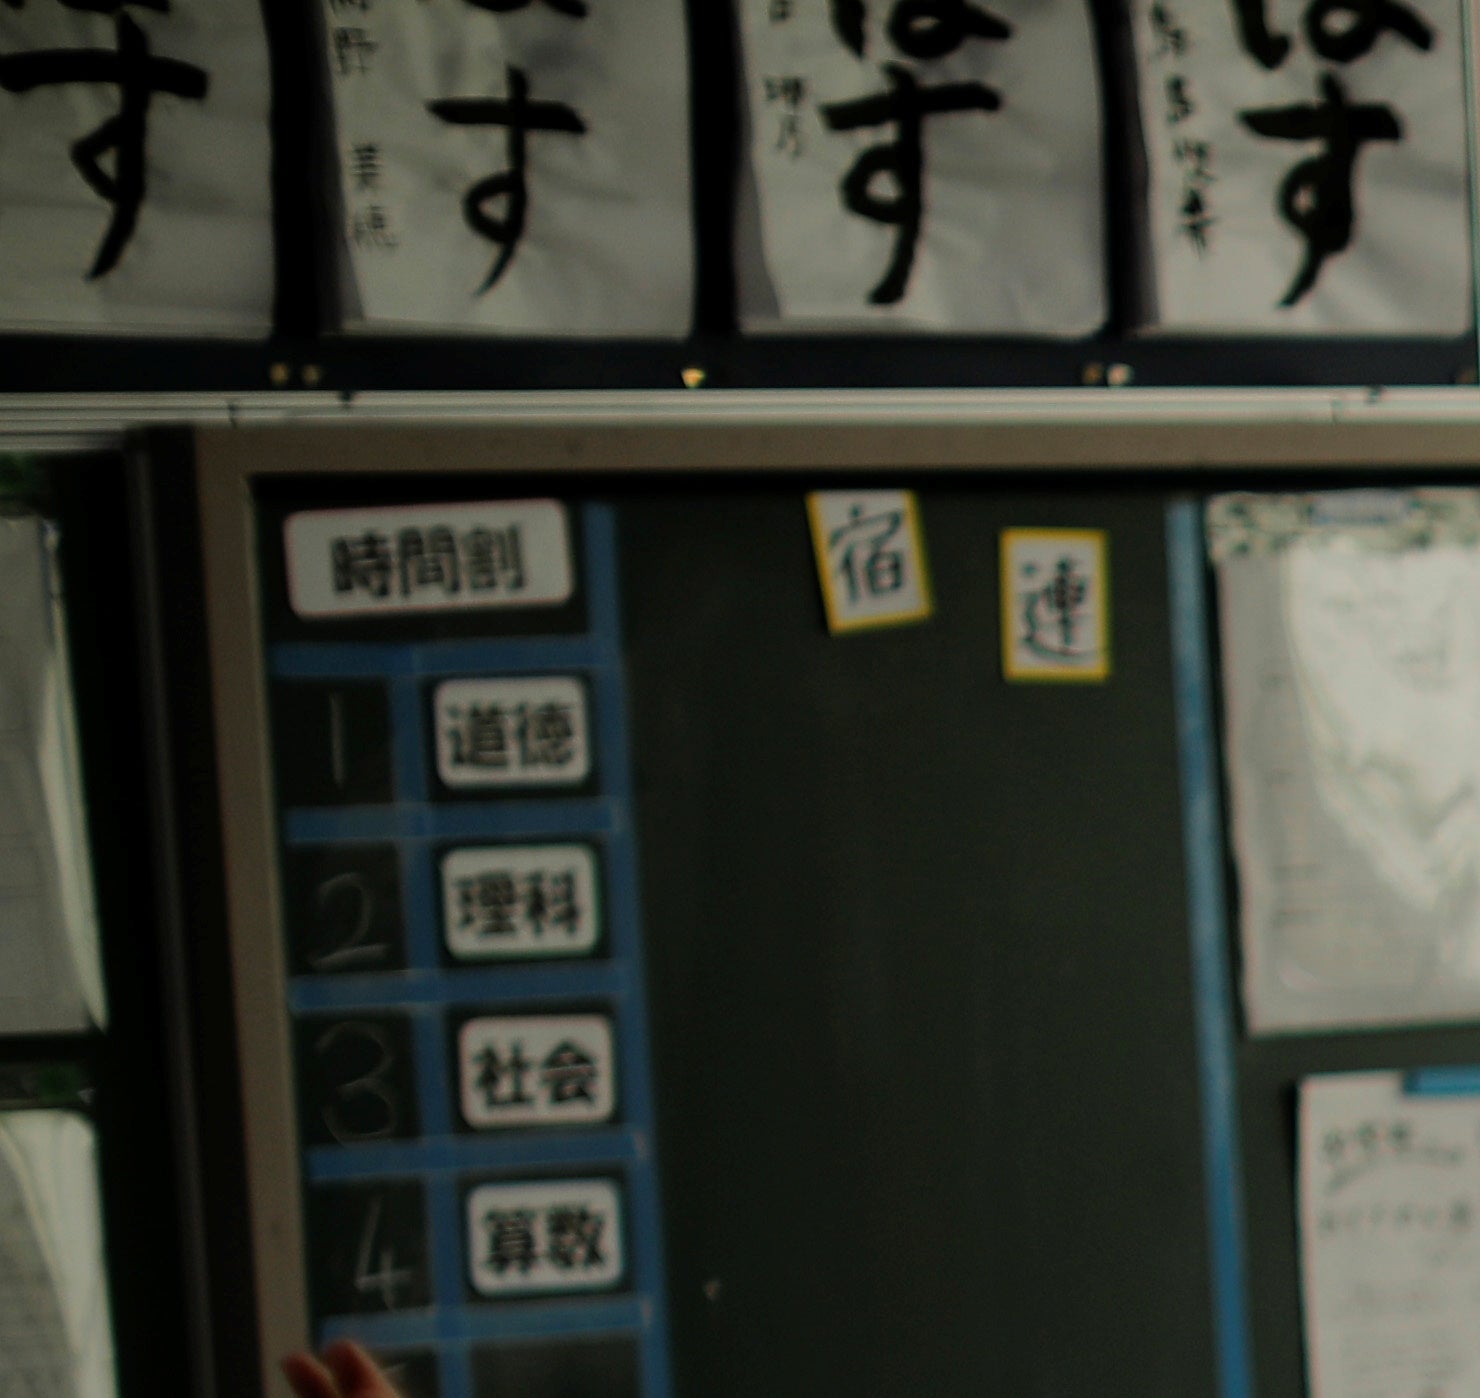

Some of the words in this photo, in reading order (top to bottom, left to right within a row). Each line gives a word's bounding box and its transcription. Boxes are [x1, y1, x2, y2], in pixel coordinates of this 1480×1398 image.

[0, 0, 209, 282] す
[425, 0, 590, 298] す
[330, 522, 526, 600] 時間割
[828, 503, 905, 607] 宿
[1022, 555, 1093, 664] 連
[447, 700, 578, 770] 道徳
[307, 870, 392, 968] 2
[455, 868, 583, 937] 理科
[472, 1041, 598, 1106] 社会
[353, 1192, 413, 1310] 4
[485, 1207, 607, 1275] 算数
